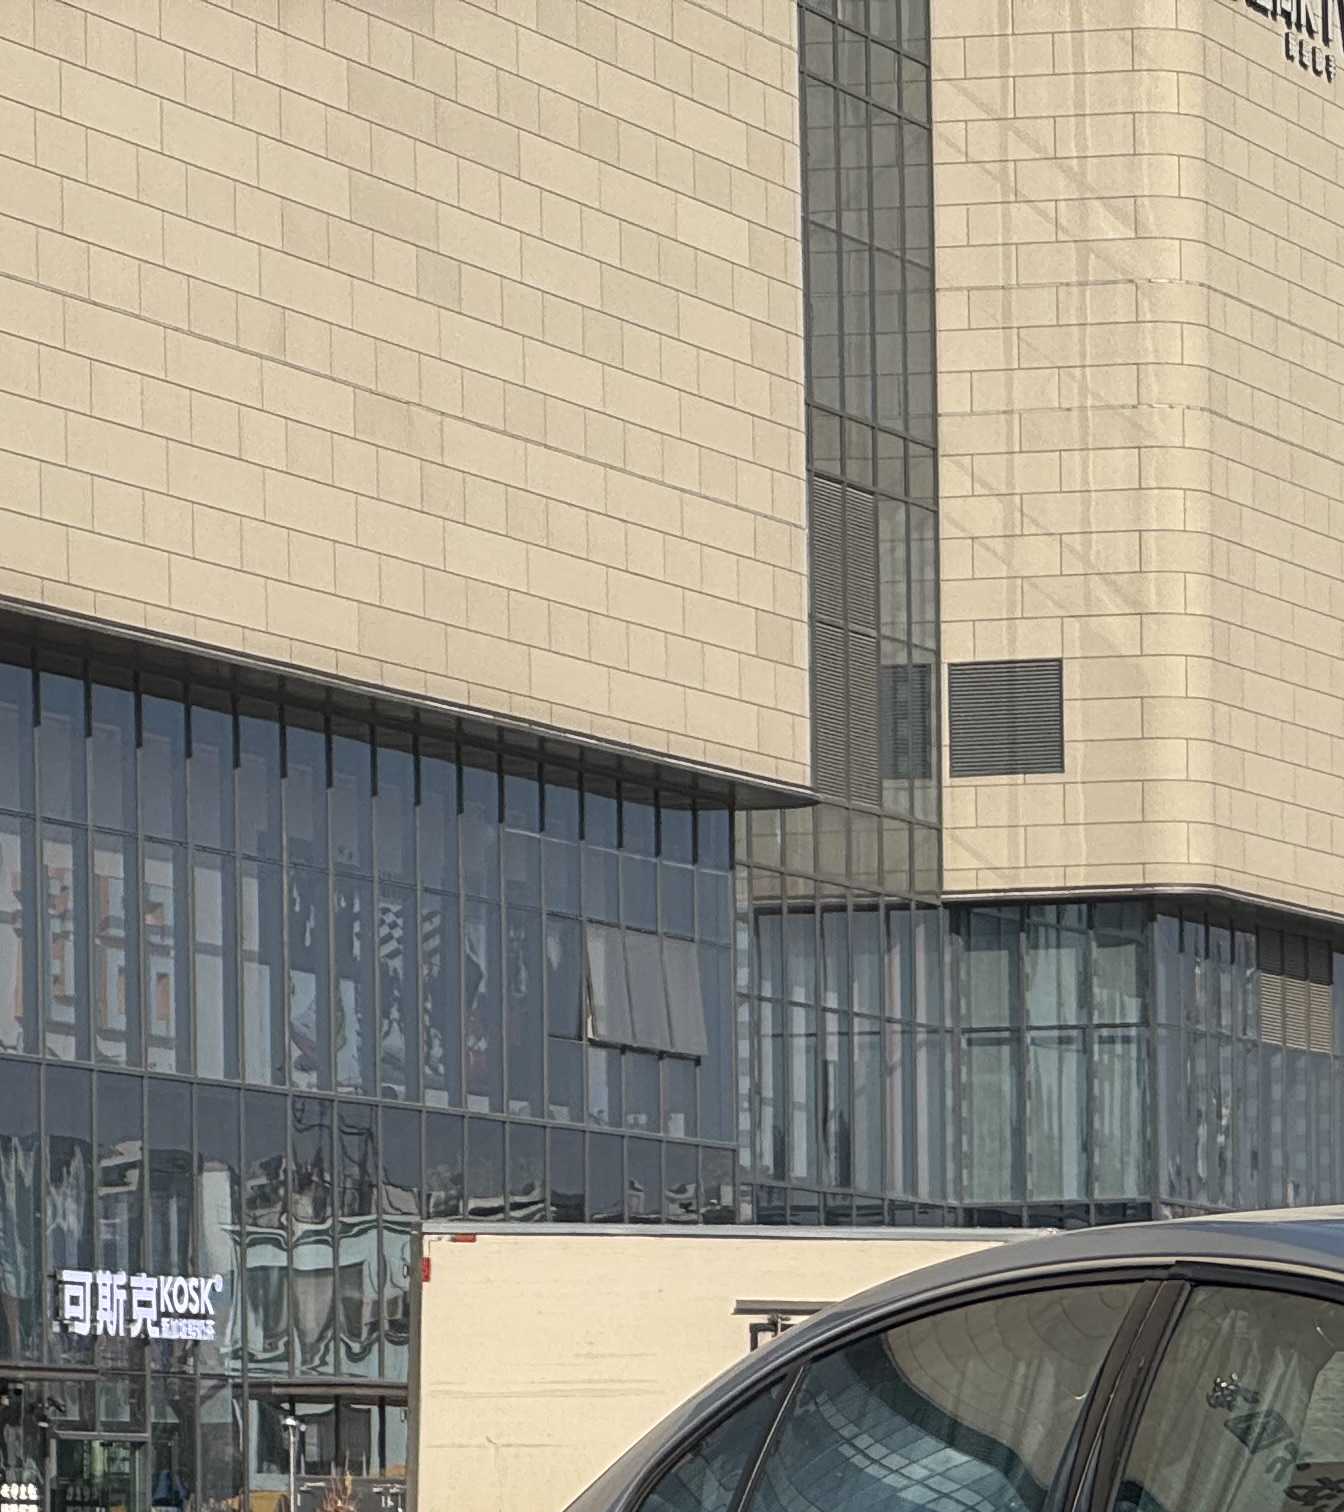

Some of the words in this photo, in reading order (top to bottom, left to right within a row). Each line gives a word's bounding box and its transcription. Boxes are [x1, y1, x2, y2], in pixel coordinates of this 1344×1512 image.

[61, 1269, 159, 1338] 可斯克
[159, 1275, 215, 1315] KOSK
